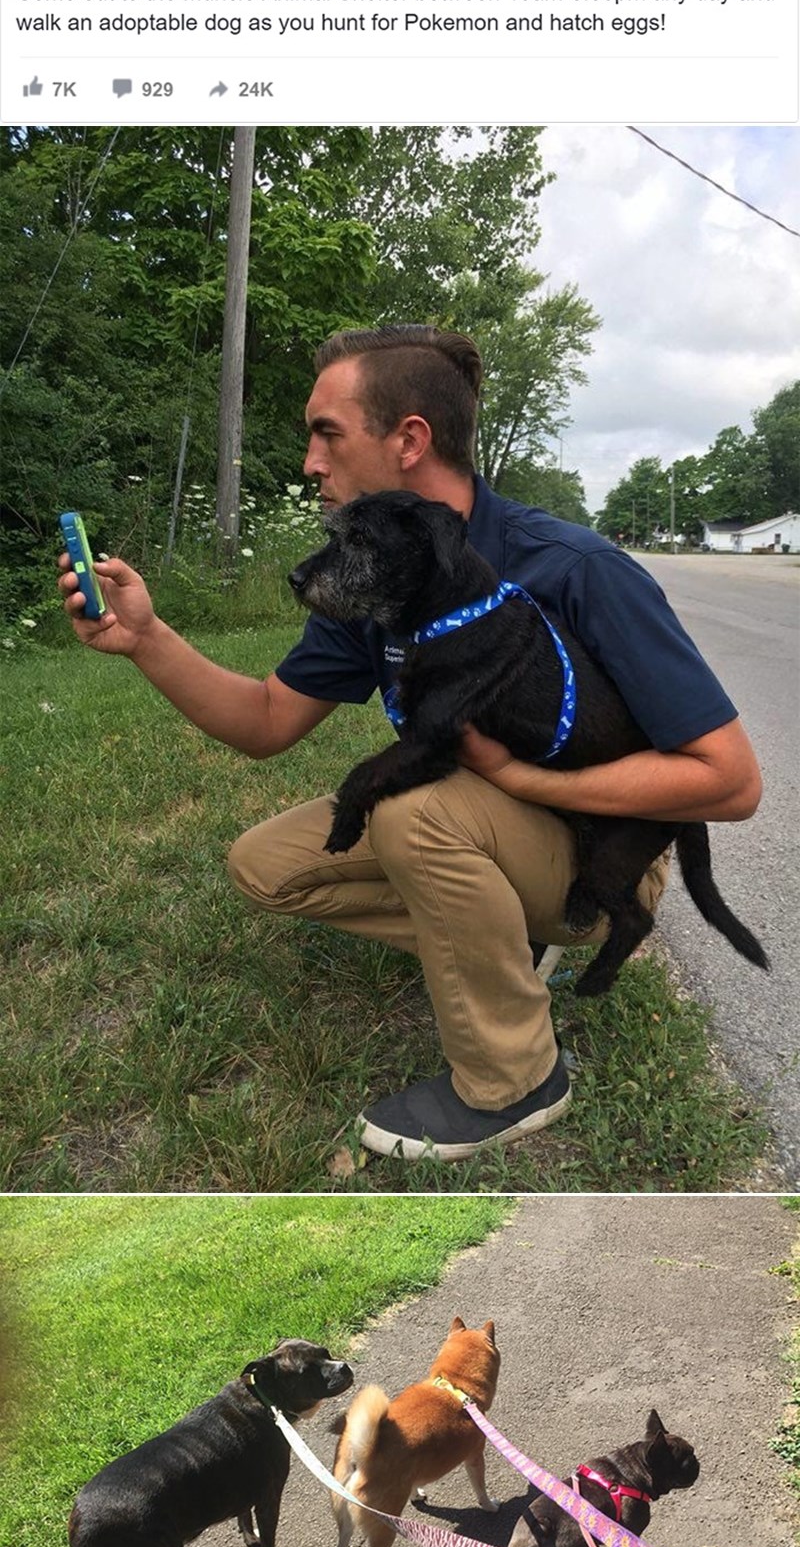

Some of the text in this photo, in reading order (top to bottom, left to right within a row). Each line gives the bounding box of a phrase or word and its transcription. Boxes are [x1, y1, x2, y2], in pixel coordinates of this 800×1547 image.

[15, 12, 666, 36] walk an adoptable dog as you hunt for Pokemon and hatch eggs!
[51, 81, 77, 98] 7K
[141, 81, 174, 98] 929
[238, 81, 274, 98] 24K
